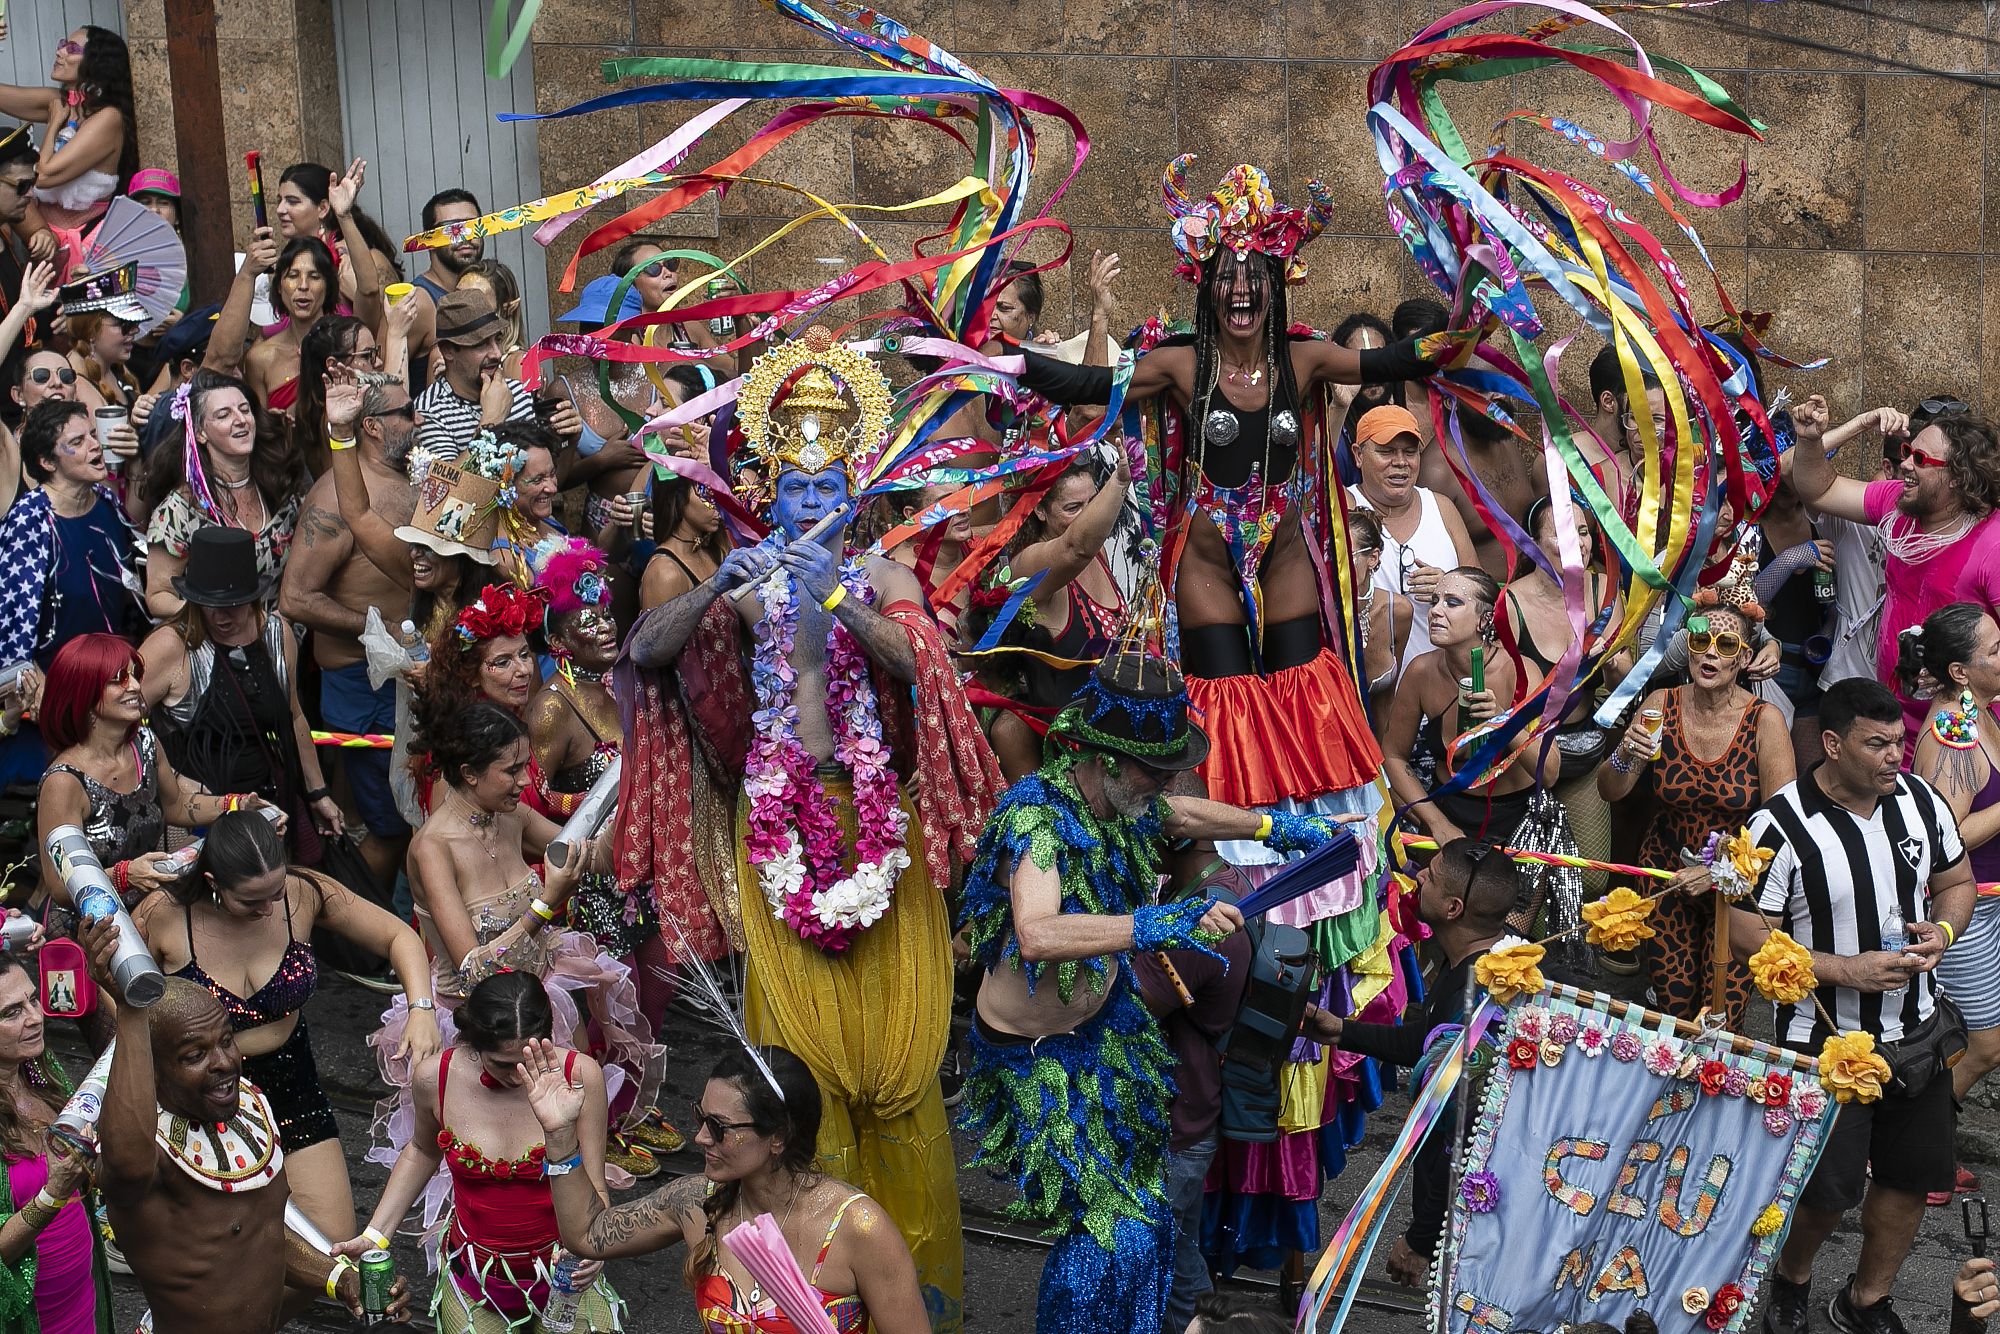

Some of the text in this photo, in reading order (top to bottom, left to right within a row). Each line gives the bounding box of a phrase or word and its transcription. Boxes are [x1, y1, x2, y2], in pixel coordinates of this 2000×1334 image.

[431, 461, 460, 483] ROLHA
[1543, 1085, 1733, 1239] CÉU
[1554, 1242, 1650, 1303] NA
